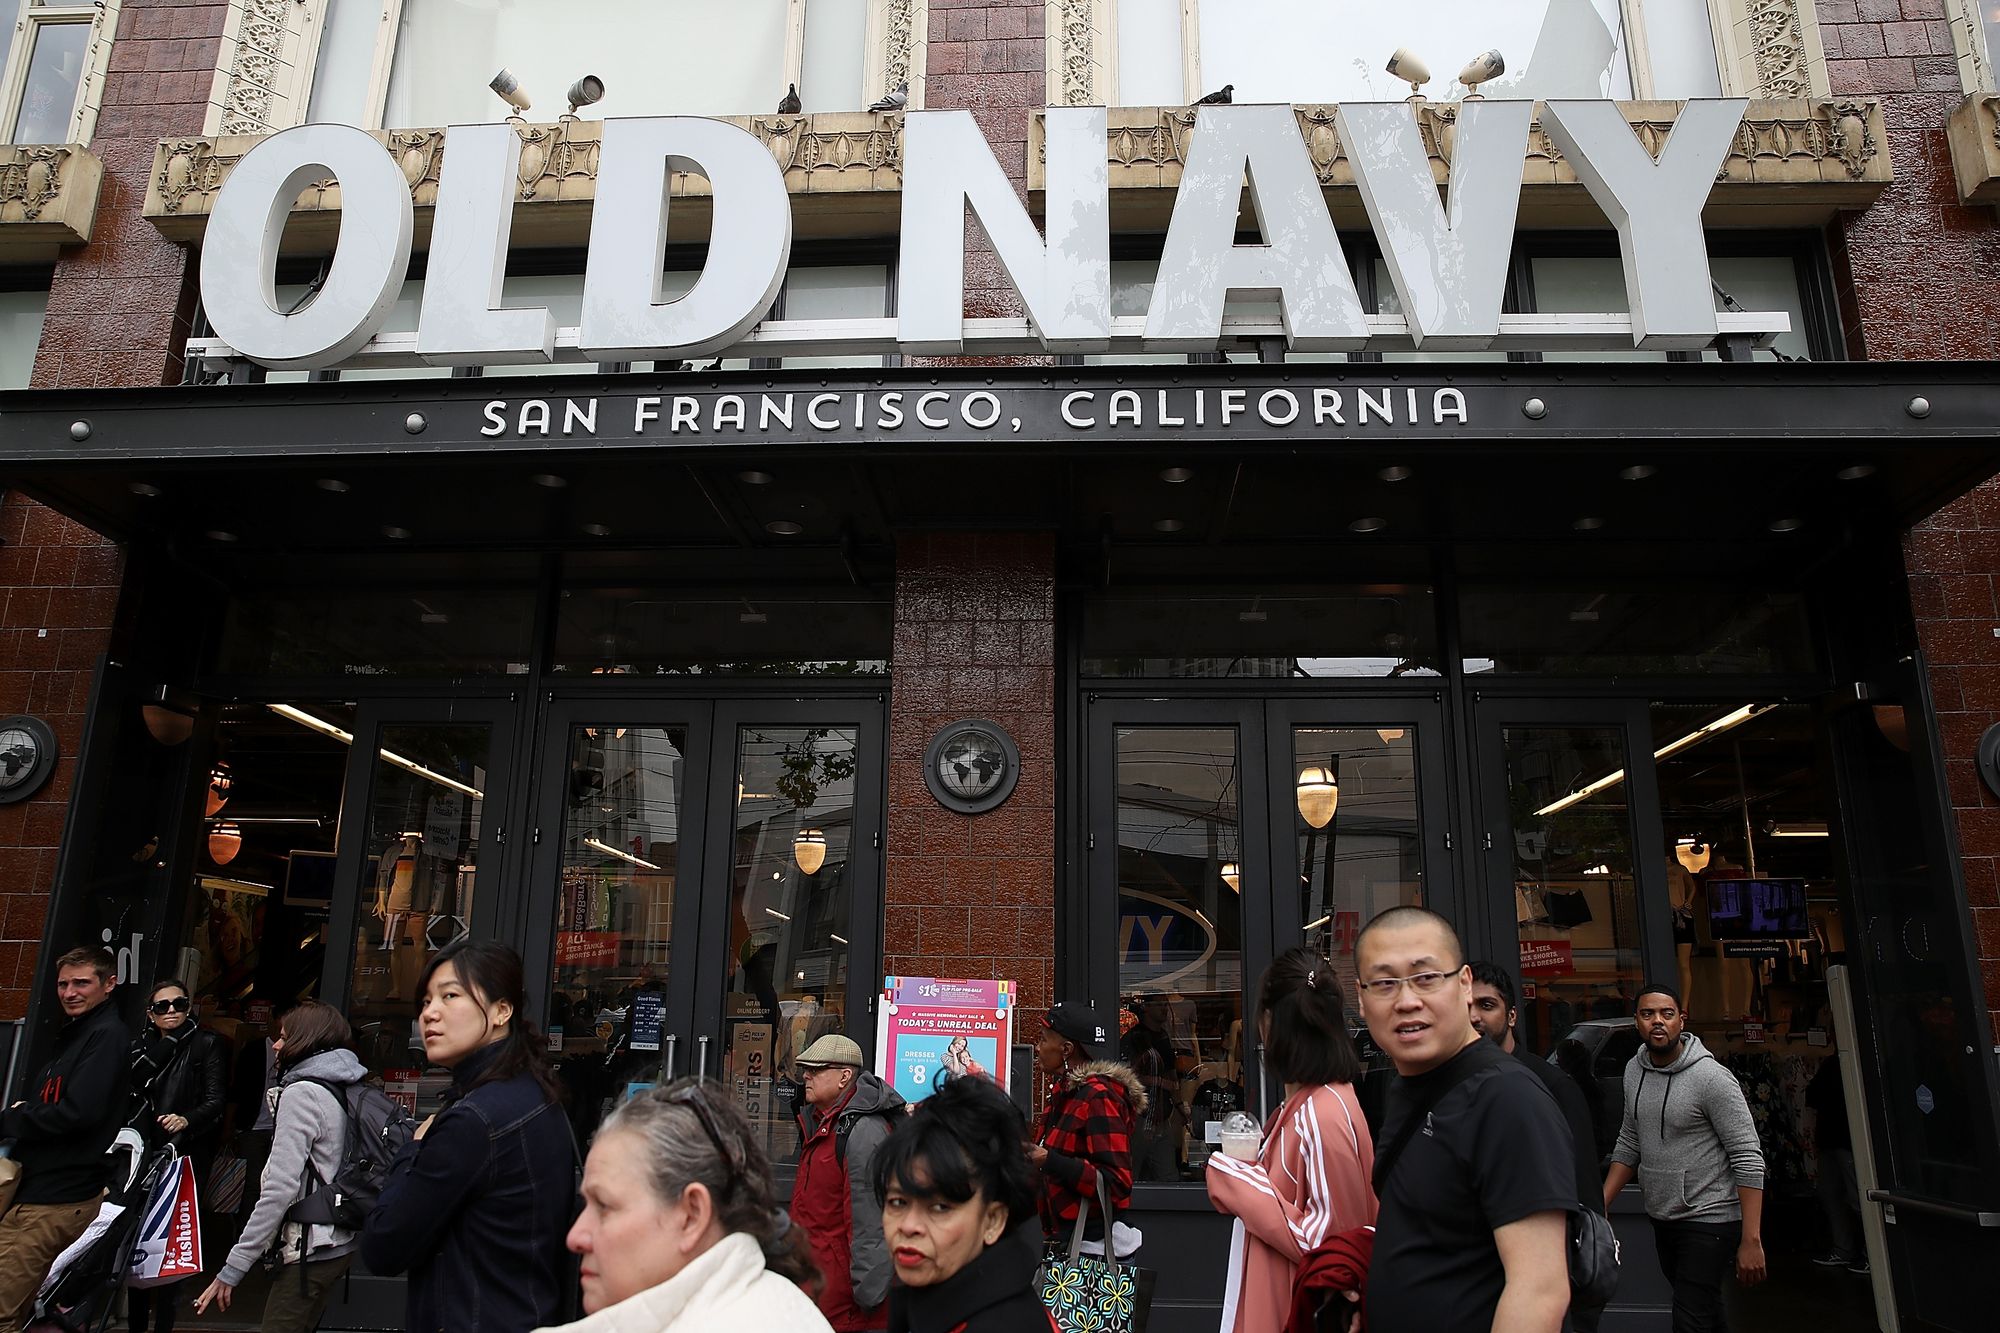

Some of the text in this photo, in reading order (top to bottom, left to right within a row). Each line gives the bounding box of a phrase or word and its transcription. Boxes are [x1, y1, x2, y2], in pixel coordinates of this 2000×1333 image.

[199, 97, 1750, 370] OLD NAVY
[480, 386, 1469, 438] SAN FRANCISCO, CALIFORNIA
[1520, 942, 1535, 955] LL
[1537, 957, 1565, 967] DRESSES
[897, 1018, 935, 1028] TODAY'S
[937, 1020, 972, 1030] UNREAL
[974, 1022, 998, 1031] DEAL
[904, 1050, 936, 1058] DRESSES
[394, 1071, 409, 1080] SALE
[908, 1063, 926, 1084] $8
[176, 1199, 198, 1271] fashion
